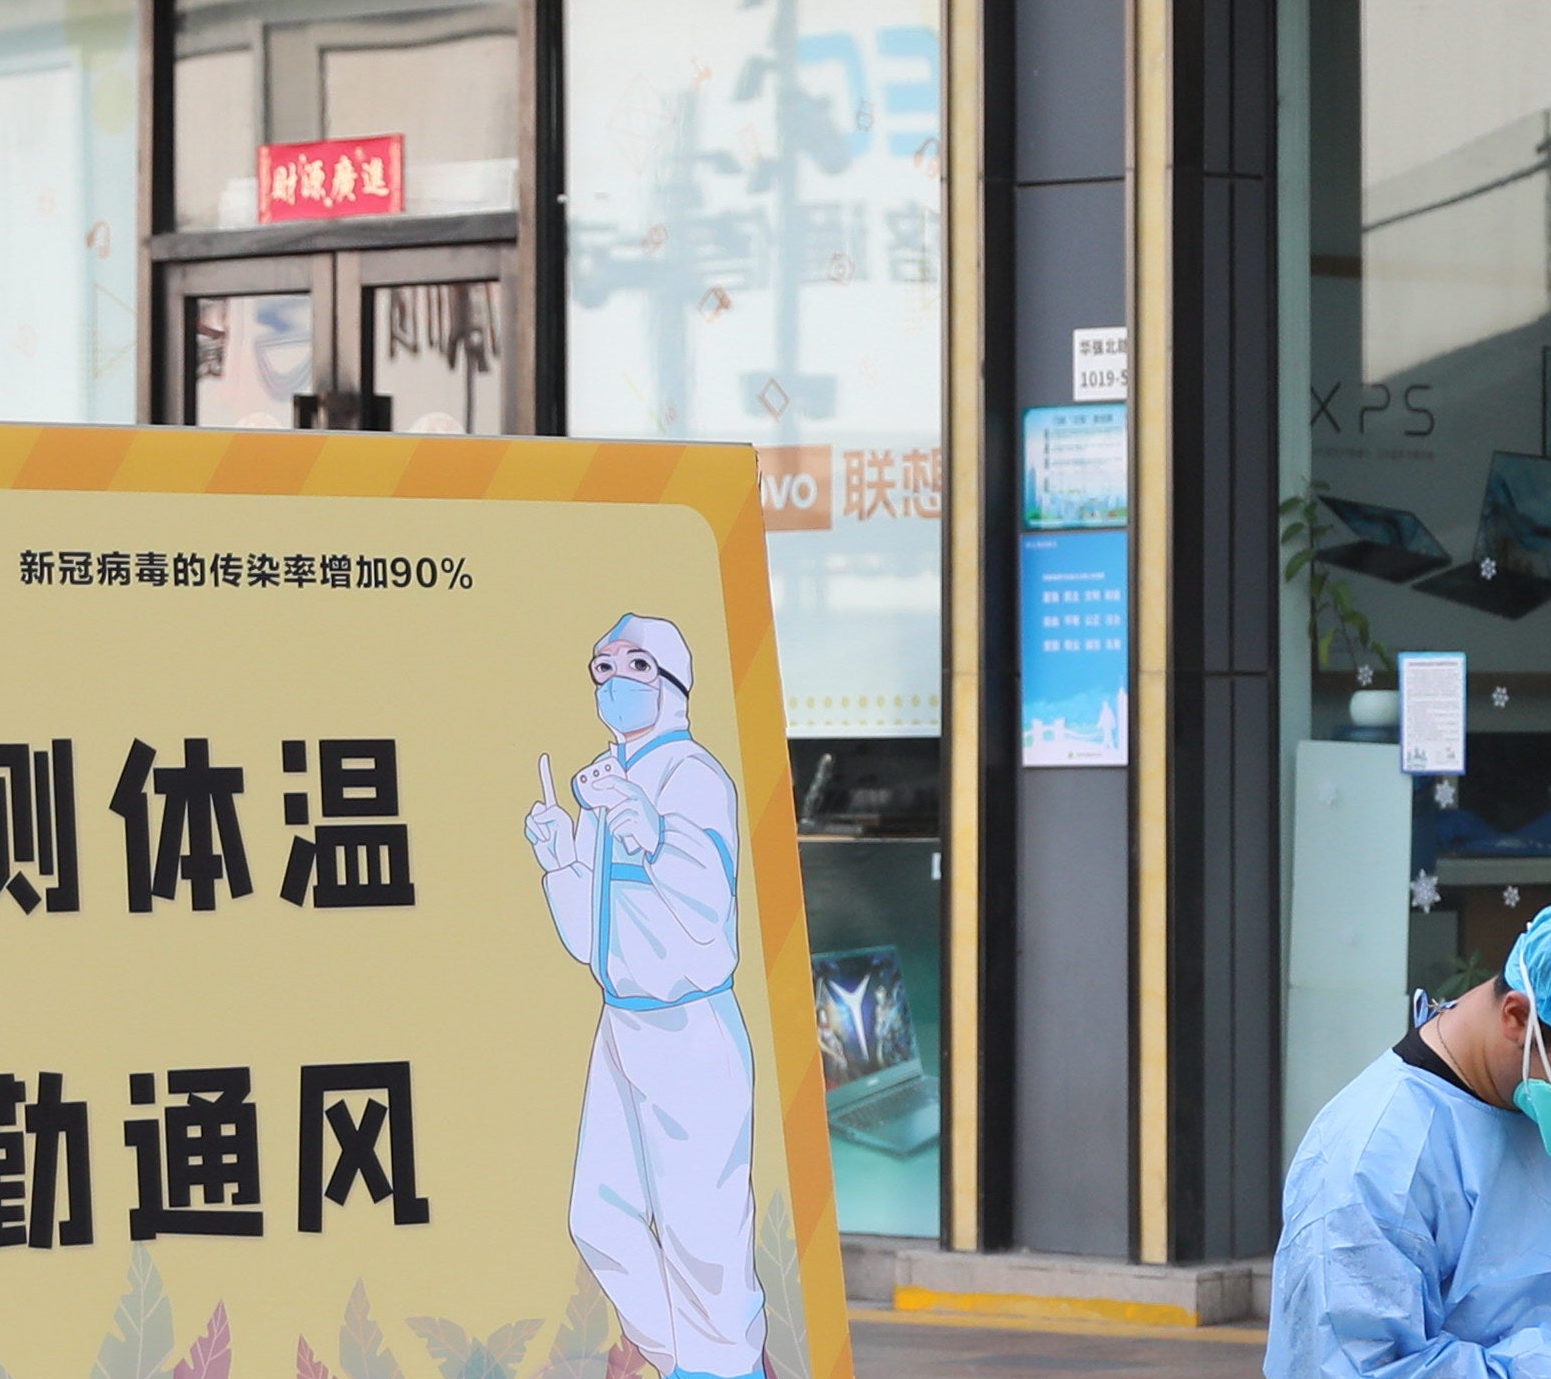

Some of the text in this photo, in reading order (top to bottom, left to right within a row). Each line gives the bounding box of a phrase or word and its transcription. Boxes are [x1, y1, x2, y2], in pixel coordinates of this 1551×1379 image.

[1310, 380, 1436, 437] XPS
[761, 447, 942, 521] vo 联想
